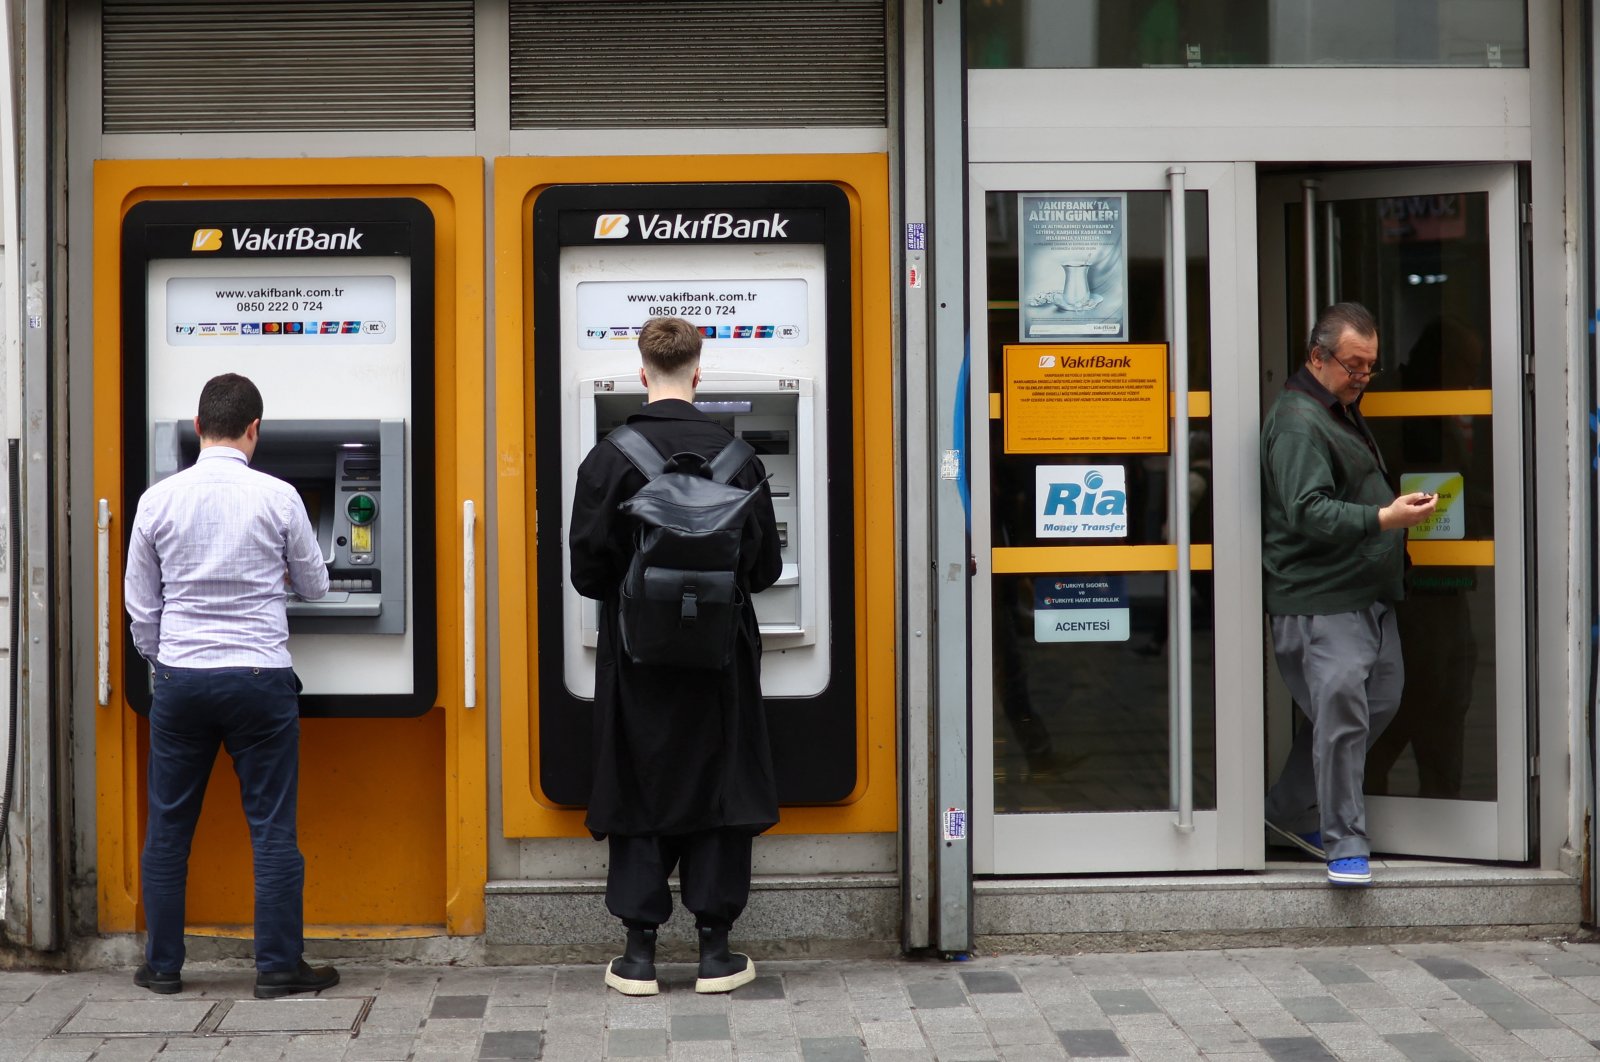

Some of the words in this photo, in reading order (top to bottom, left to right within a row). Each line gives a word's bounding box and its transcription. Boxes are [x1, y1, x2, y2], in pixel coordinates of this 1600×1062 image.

[1028, 210, 1065, 221] ALTIN
[638, 213, 790, 239] VakıfBank
[231, 227, 364, 251] VakıfBank
[215, 288, 344, 299] www.vakifbank.com.tr
[627, 291, 757, 302] www.vakifbank.com.tr
[236, 301, 265, 312] 0850
[267, 301, 289, 312] 222
[291, 301, 299, 311] 0
[302, 301, 323, 311] 724
[648, 306, 677, 316] 0850
[680, 305, 702, 316] 222
[704, 305, 712, 315] 0
[715, 305, 736, 315] 724
[175, 324, 195, 335] troy
[586, 329, 607, 339] troy
[1060, 355, 1132, 368] VakıfBank
[1043, 470, 1126, 516] Ria
[1043, 523, 1079, 533] Money
[1081, 522, 1126, 533] Transfer
[1055, 619, 1110, 631] ACENTESİ
